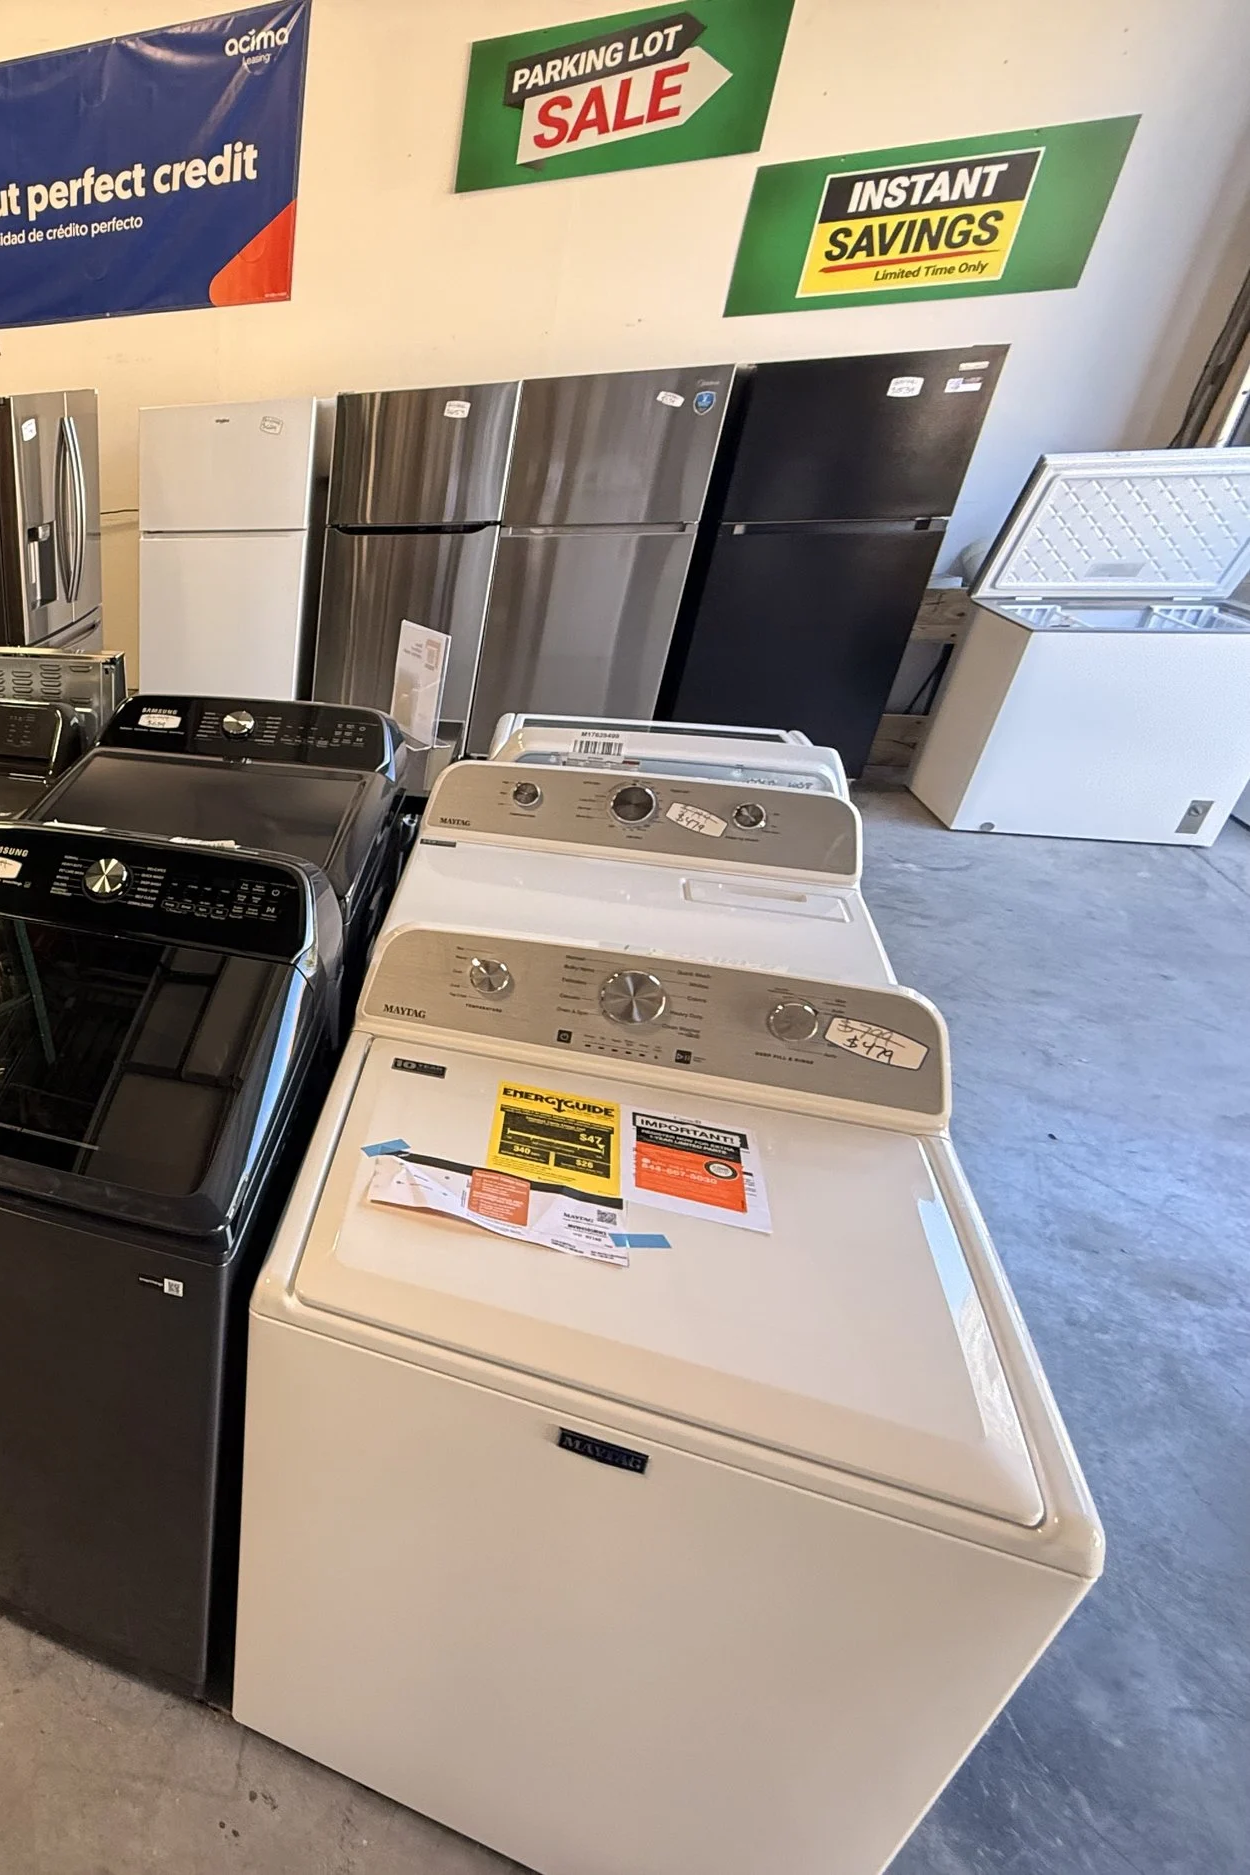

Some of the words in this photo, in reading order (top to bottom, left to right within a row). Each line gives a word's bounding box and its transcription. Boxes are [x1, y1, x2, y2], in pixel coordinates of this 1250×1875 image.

[225, 27, 289, 57] acima
[512, 41, 624, 94] PARKING
[628, 24, 683, 62] LOT
[533, 62, 690, 149] SALE
[27, 163, 146, 221] perfect
[153, 141, 258, 194] credit
[847, 163, 1009, 214] INSTANT
[28, 228, 44, 243] de
[46, 218, 89, 240] crédito
[91, 215, 143, 238] perfecto
[824, 210, 1005, 262] SAVINGS
[874, 265, 920, 281] Limited
[924, 263, 955, 277] Time
[958, 261, 989, 275] Only
[142, 707, 178, 715] SAMSUNG
[440, 817, 471, 827] MAYTAG
[383, 1003, 426, 1019] MAYTAG
[843, 1035, 894, 1064] $479
[502, 1087, 615, 1118] ENERGYGUIDE
[579, 1133, 603, 1145] $47
[640, 1118, 734, 1145] IMPORTANT!
[561, 1436, 642, 1470] MAYTAG
